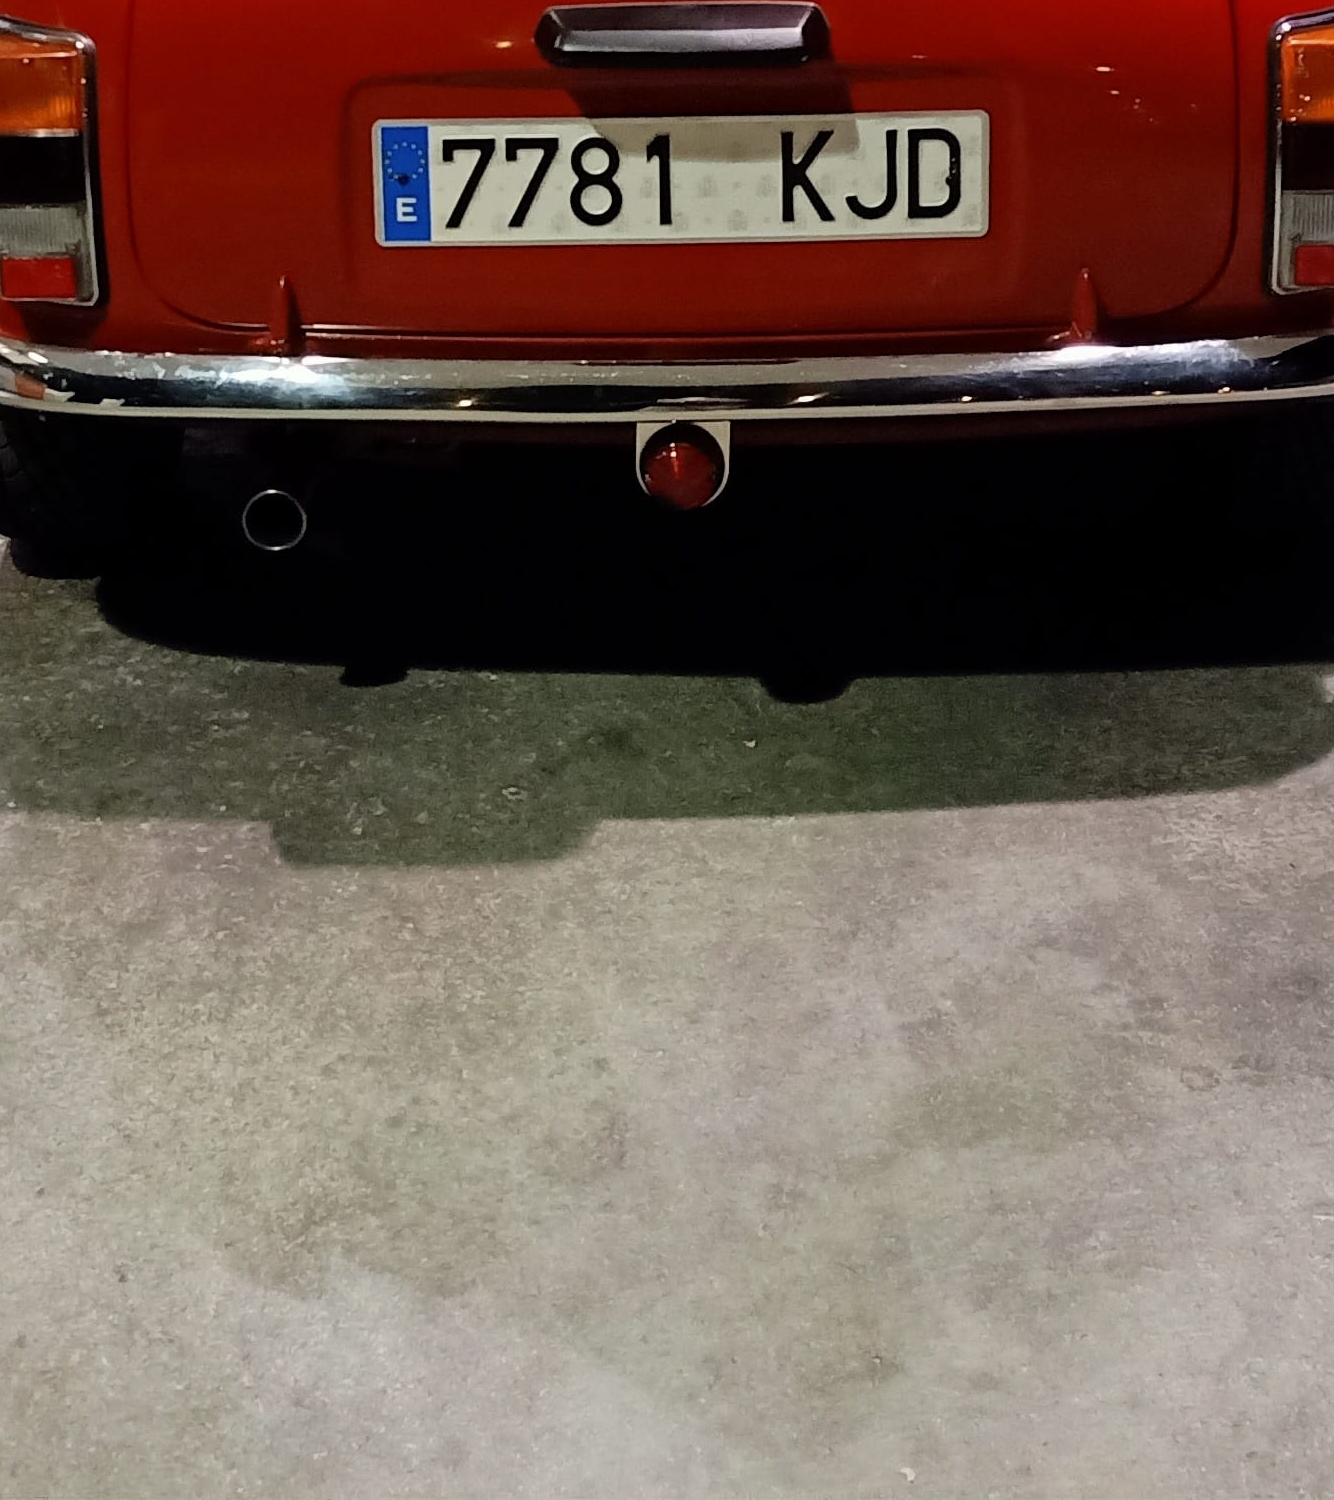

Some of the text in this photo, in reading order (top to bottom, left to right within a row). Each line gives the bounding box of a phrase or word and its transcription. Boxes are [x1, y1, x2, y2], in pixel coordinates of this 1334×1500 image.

[396, 128, 961, 228] E 7781 KJD
